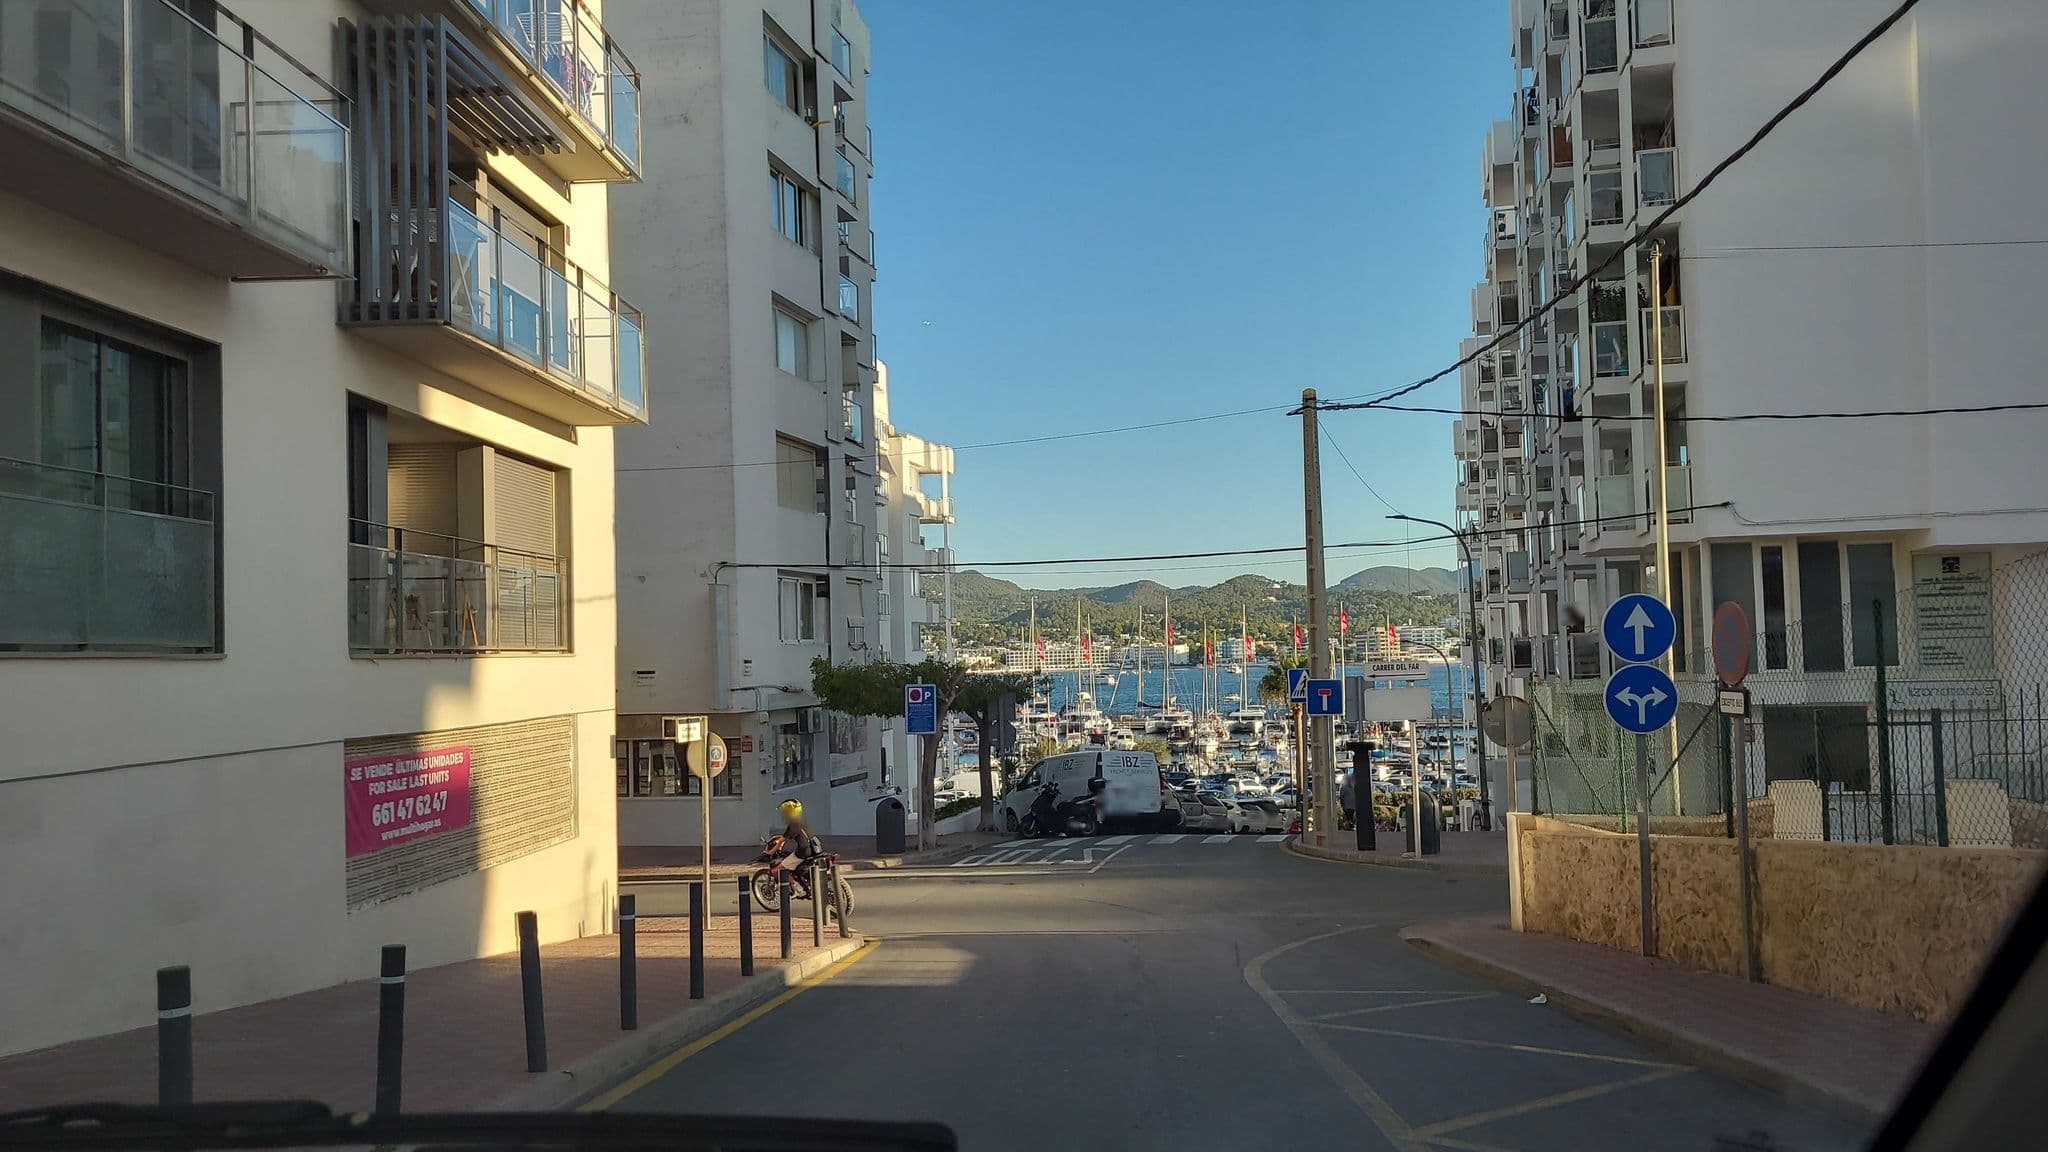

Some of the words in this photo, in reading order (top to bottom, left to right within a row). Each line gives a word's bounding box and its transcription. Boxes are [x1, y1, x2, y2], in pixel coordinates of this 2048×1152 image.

[1372, 664, 1395, 672] CARRER
[924, 691, 932, 700] P
[350, 767, 363, 781] SE
[364, 762, 394, 779] VENDE
[395, 758, 429, 774] ÚLTIMAS
[428, 752, 464, 769] UNIDADES
[1121, 756, 1140, 768] IBZ
[368, 781, 386, 796] FOR
[386, 777, 408, 792] SALE
[409, 773, 429, 789] LAST
[428, 769, 450, 785] UNITS
[372, 801, 395, 827] 661
[397, 797, 415, 820] 47
[415, 793, 432, 816] 62
[432, 790, 448, 812] 47
